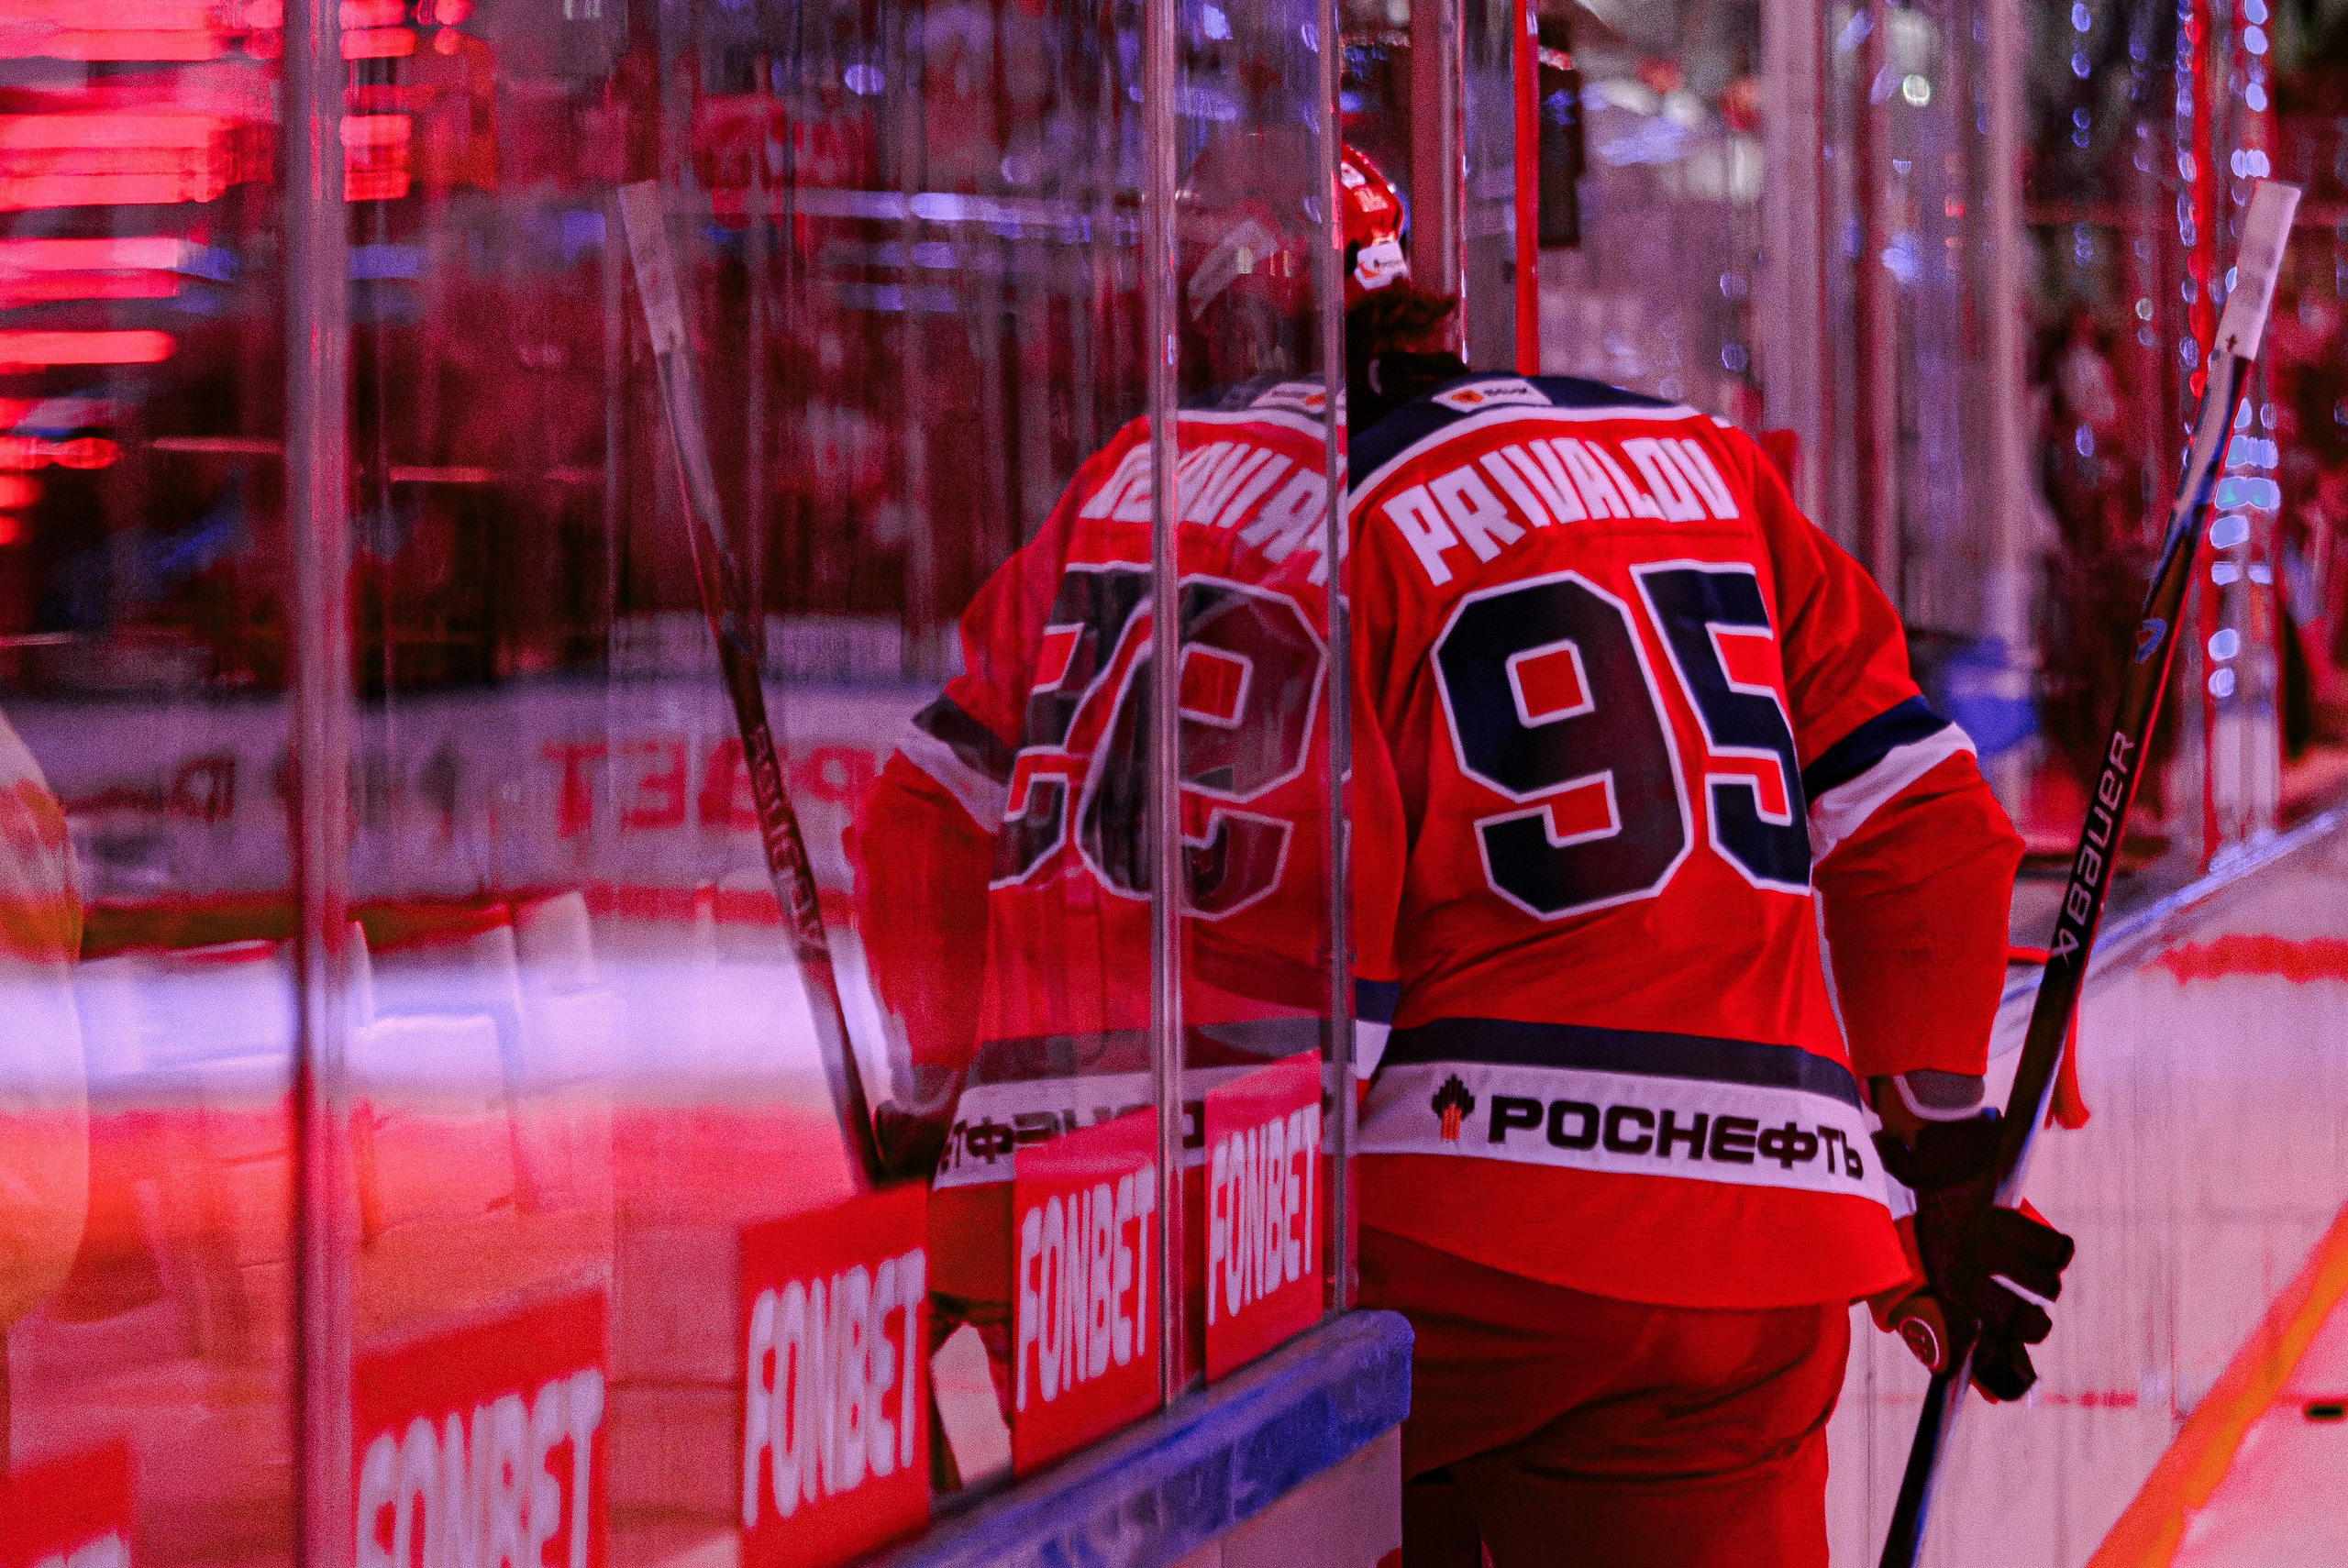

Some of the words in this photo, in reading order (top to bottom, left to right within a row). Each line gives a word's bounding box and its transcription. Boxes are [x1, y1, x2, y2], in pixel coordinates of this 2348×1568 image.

[1382, 437, 1740, 586] PRIVALOV
[1431, 558, 1813, 922] 95
[1207, 1101, 1321, 1326] FONBET
[1488, 1095, 1864, 1180] РОСНЕФТЬ
[742, 1246, 925, 1528] FONBET
[1015, 1163, 1156, 1413] FONBET
